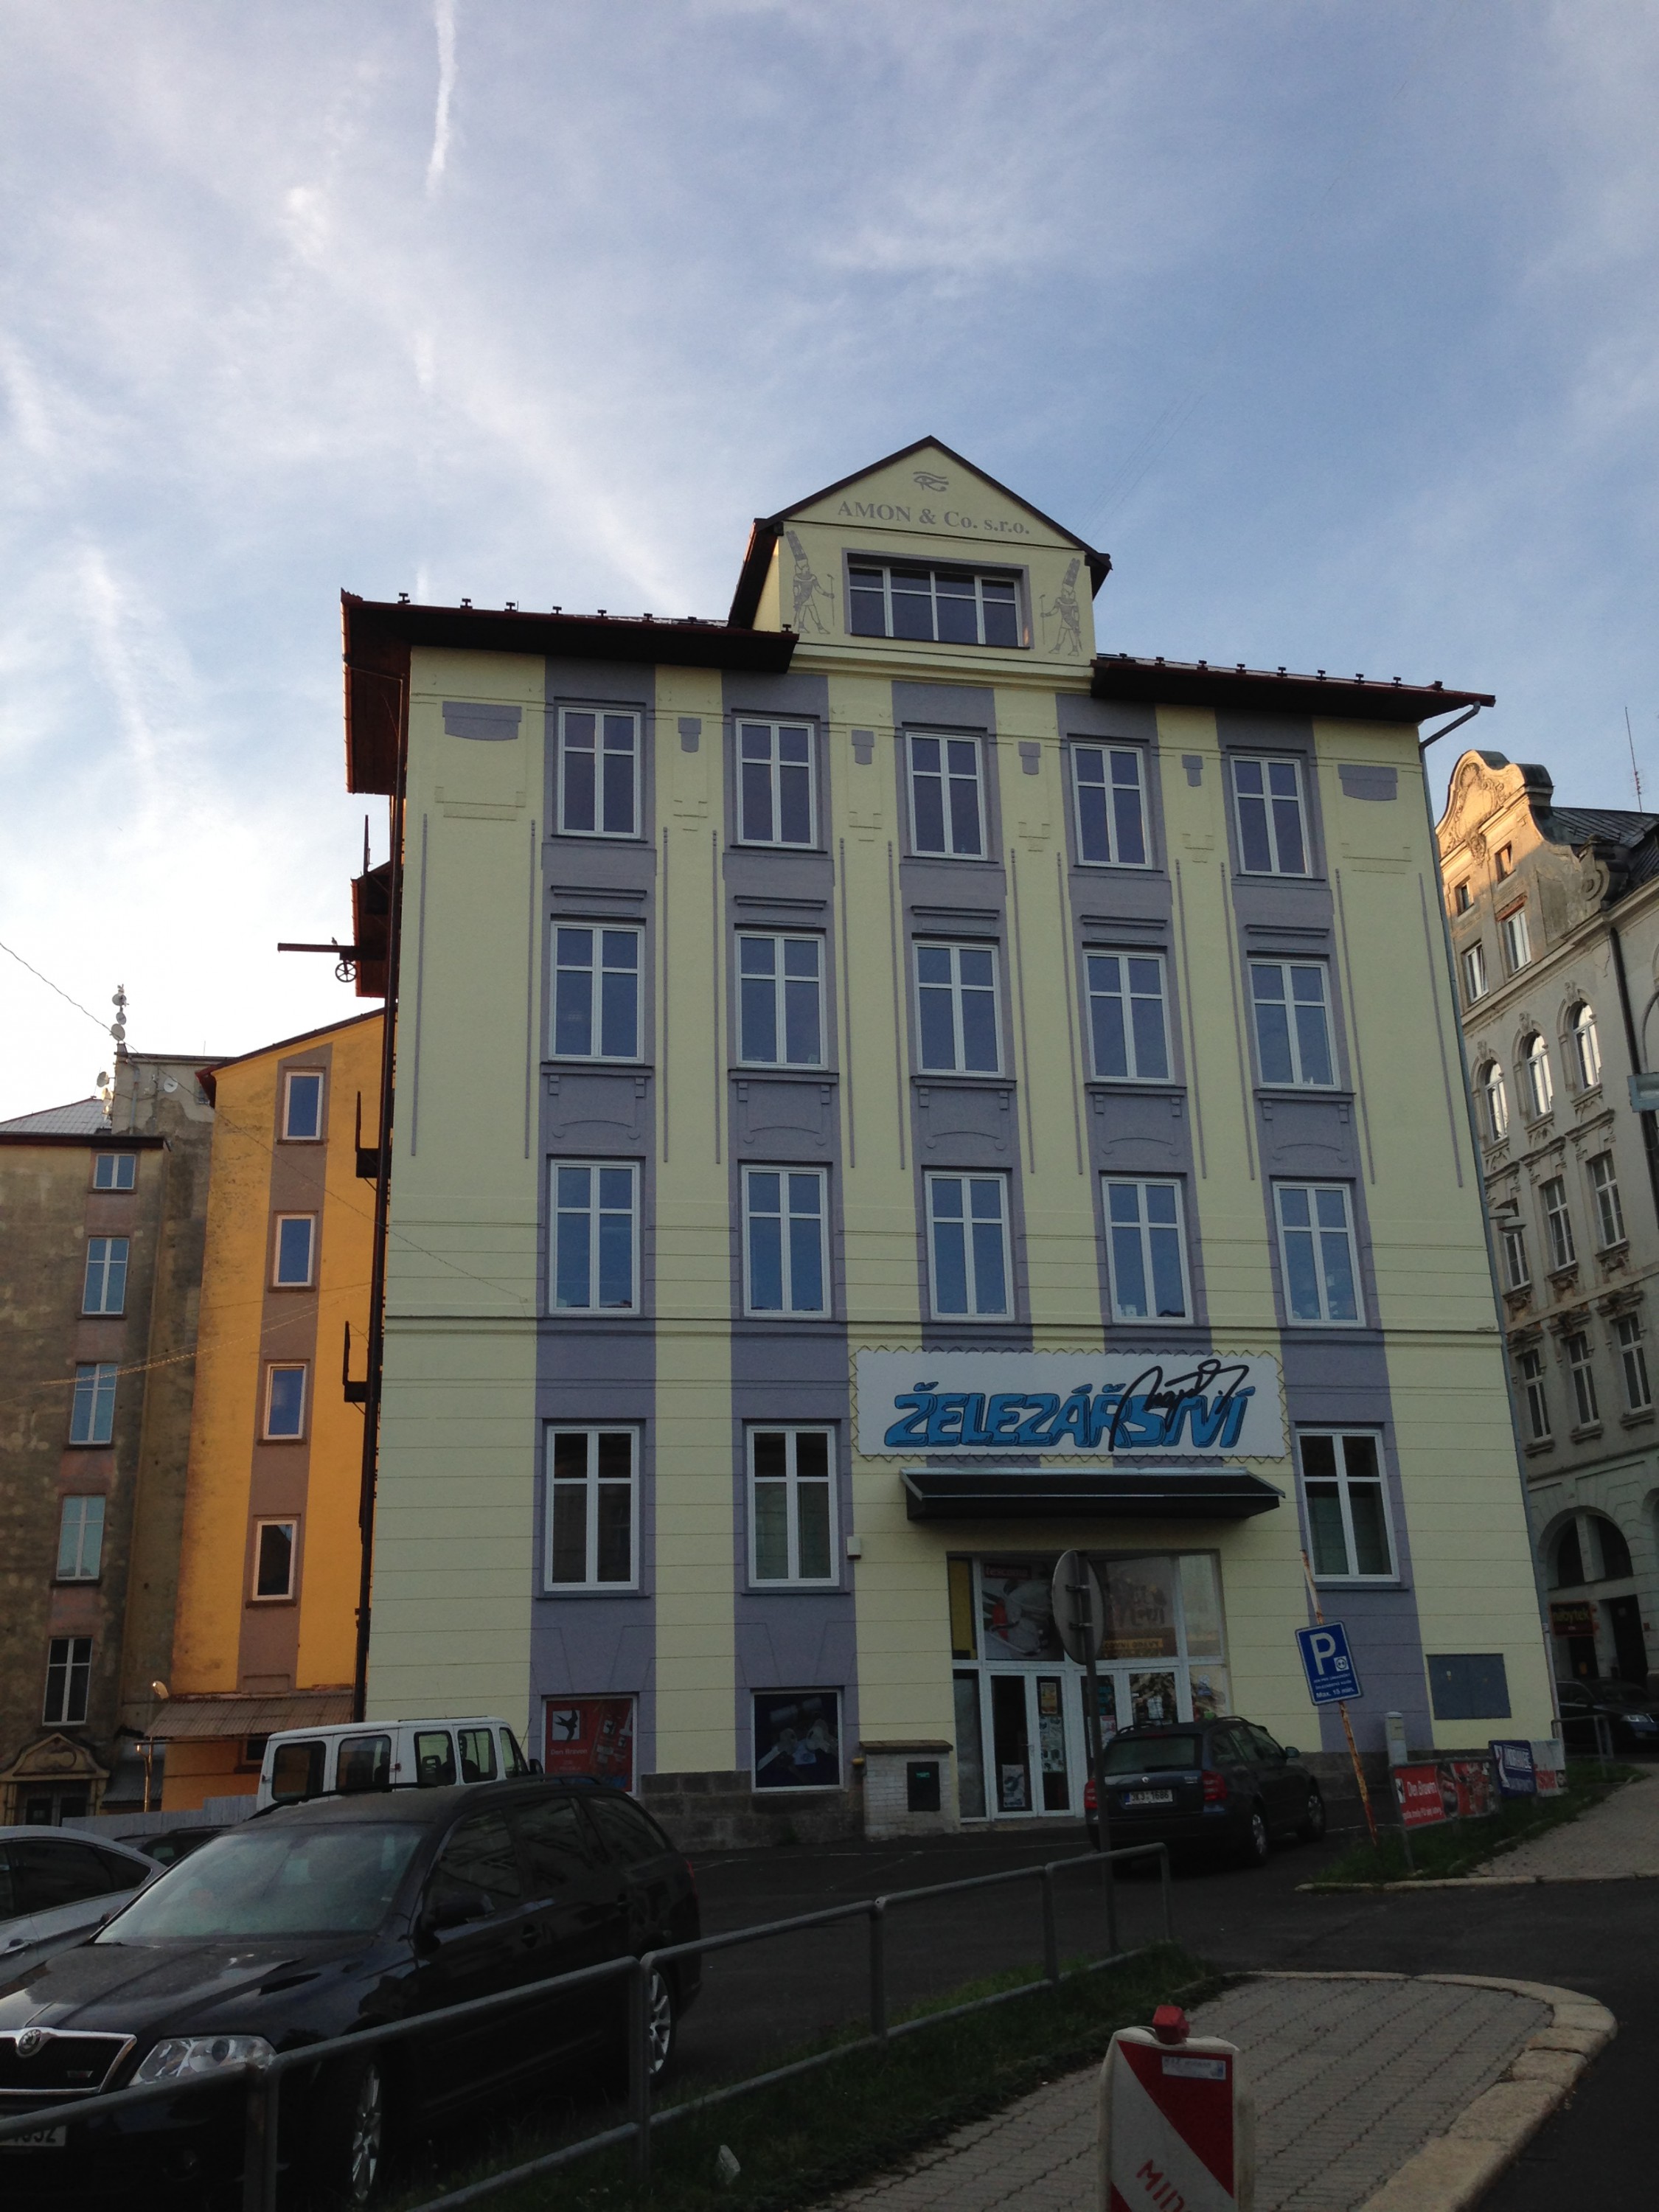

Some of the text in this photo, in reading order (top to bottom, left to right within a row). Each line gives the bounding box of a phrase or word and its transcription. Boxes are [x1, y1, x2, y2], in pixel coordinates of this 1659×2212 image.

[838, 501, 1030, 535] AMON & Co. s.r.o.
[884, 1381, 1256, 1449] ŽELEZÁŘSTVÍ
[1310, 1632, 1336, 1675] P
